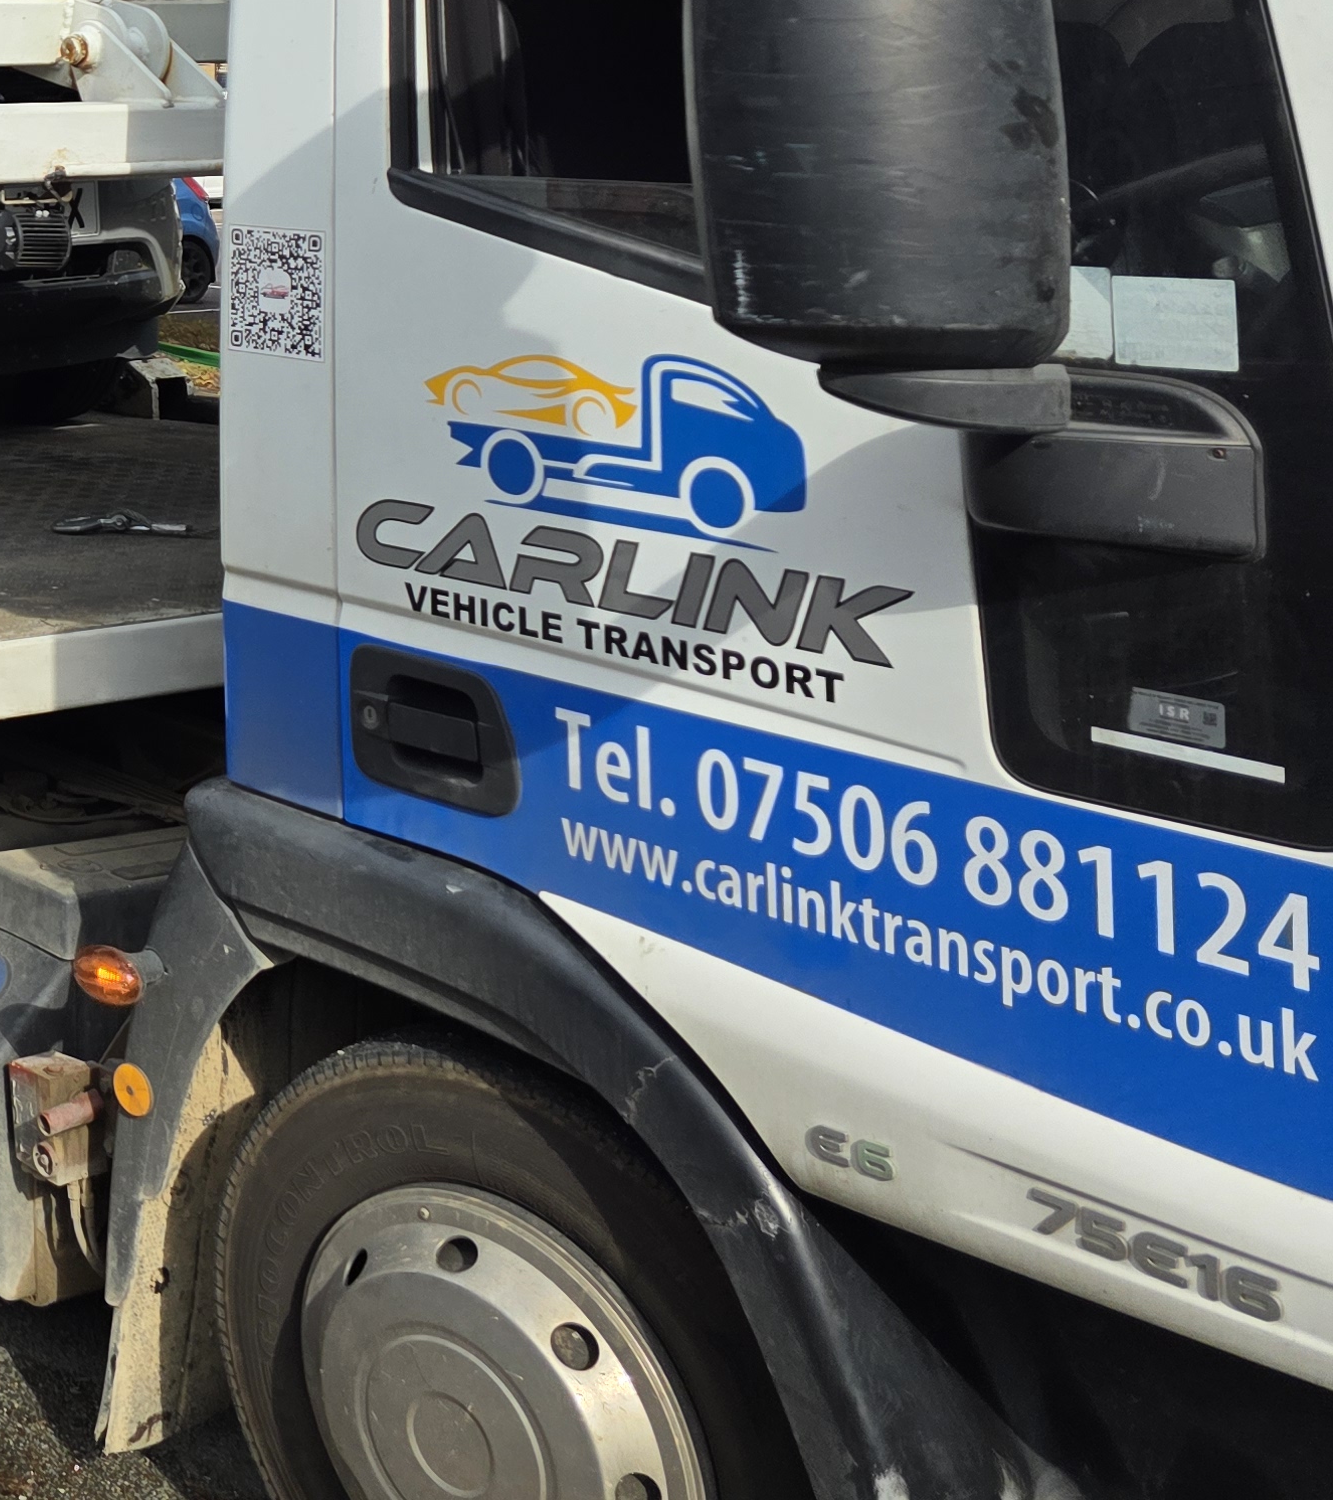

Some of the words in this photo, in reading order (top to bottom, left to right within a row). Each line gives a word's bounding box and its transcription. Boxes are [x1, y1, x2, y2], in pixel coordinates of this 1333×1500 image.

[355, 496, 916, 670] CARLINK
[404, 582, 565, 645] VEHICLE
[576, 616, 846, 705] TRANSPORT
[554, 706, 677, 818] Tel.
[696, 747, 940, 888] 07506
[962, 814, 1321, 993] 881124
[560, 816, 1320, 1083] www.carlinktransport.co.uk
[805, 1125, 894, 1182] E6
[1026, 1187, 1285, 1323] 75E16
